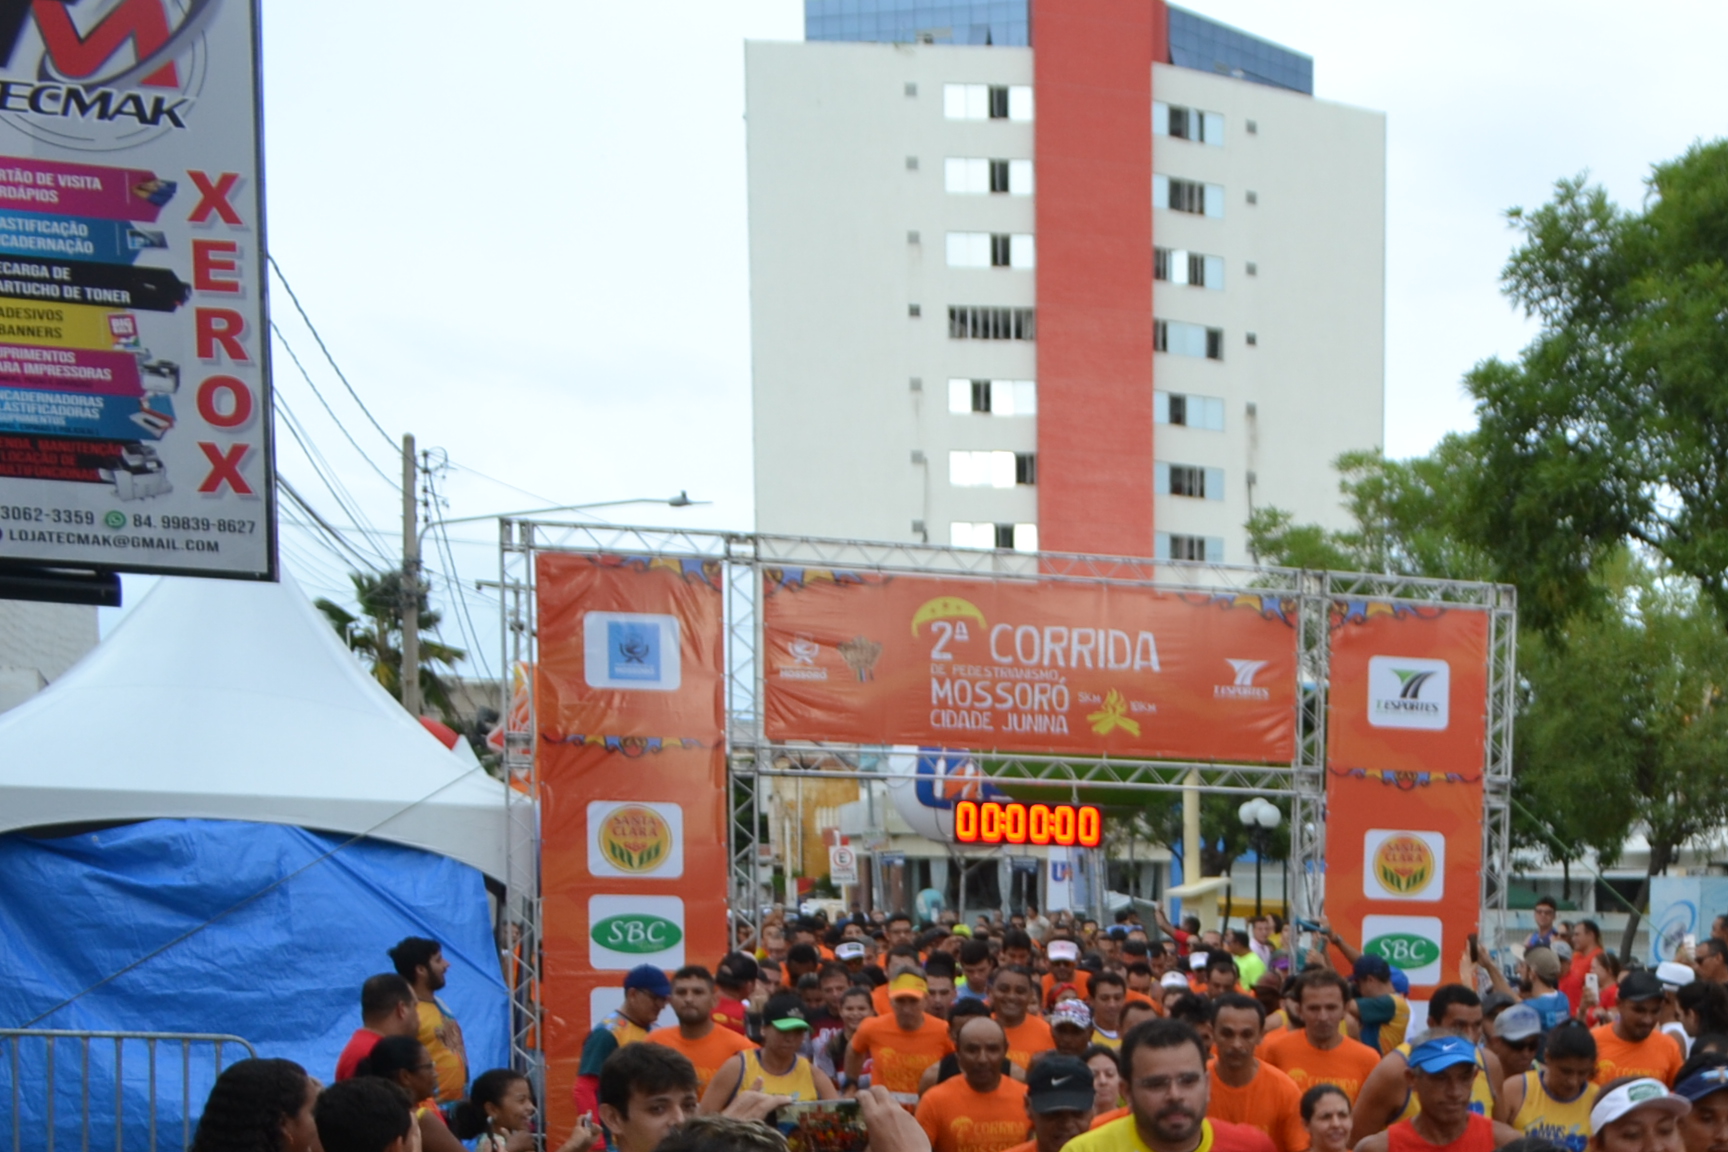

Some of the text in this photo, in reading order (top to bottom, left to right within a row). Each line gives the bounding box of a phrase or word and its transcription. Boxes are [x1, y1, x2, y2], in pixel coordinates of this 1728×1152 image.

[36, 172, 54, 187] DE
[57, 173, 102, 191] VISITA
[0, 233, 94, 255] CADERNAÇÃO
[52, 265, 71, 281] DE
[62, 284, 81, 300] DE
[84, 286, 131, 304] TONER
[0, 306, 63, 322] ADESIVOS
[0, 323, 62, 339] BANNERS
[23, 362, 112, 381] IMPRESSORAS
[1, 505, 95, 526] 3062-3359
[9, 528, 219, 553] LOJATECMAK@GMAIL.COM
[989, 622, 1161, 672] CORRIDA
[930, 663, 947, 676] DE
[930, 676, 1070, 712] MOSSORÓ
[930, 709, 1069, 735] CIDADE JUNINA
[613, 815, 658, 827] SANTA
[611, 826, 658, 838] CLARA
[607, 919, 667, 945] SBC
[1379, 938, 1428, 961] SBC
